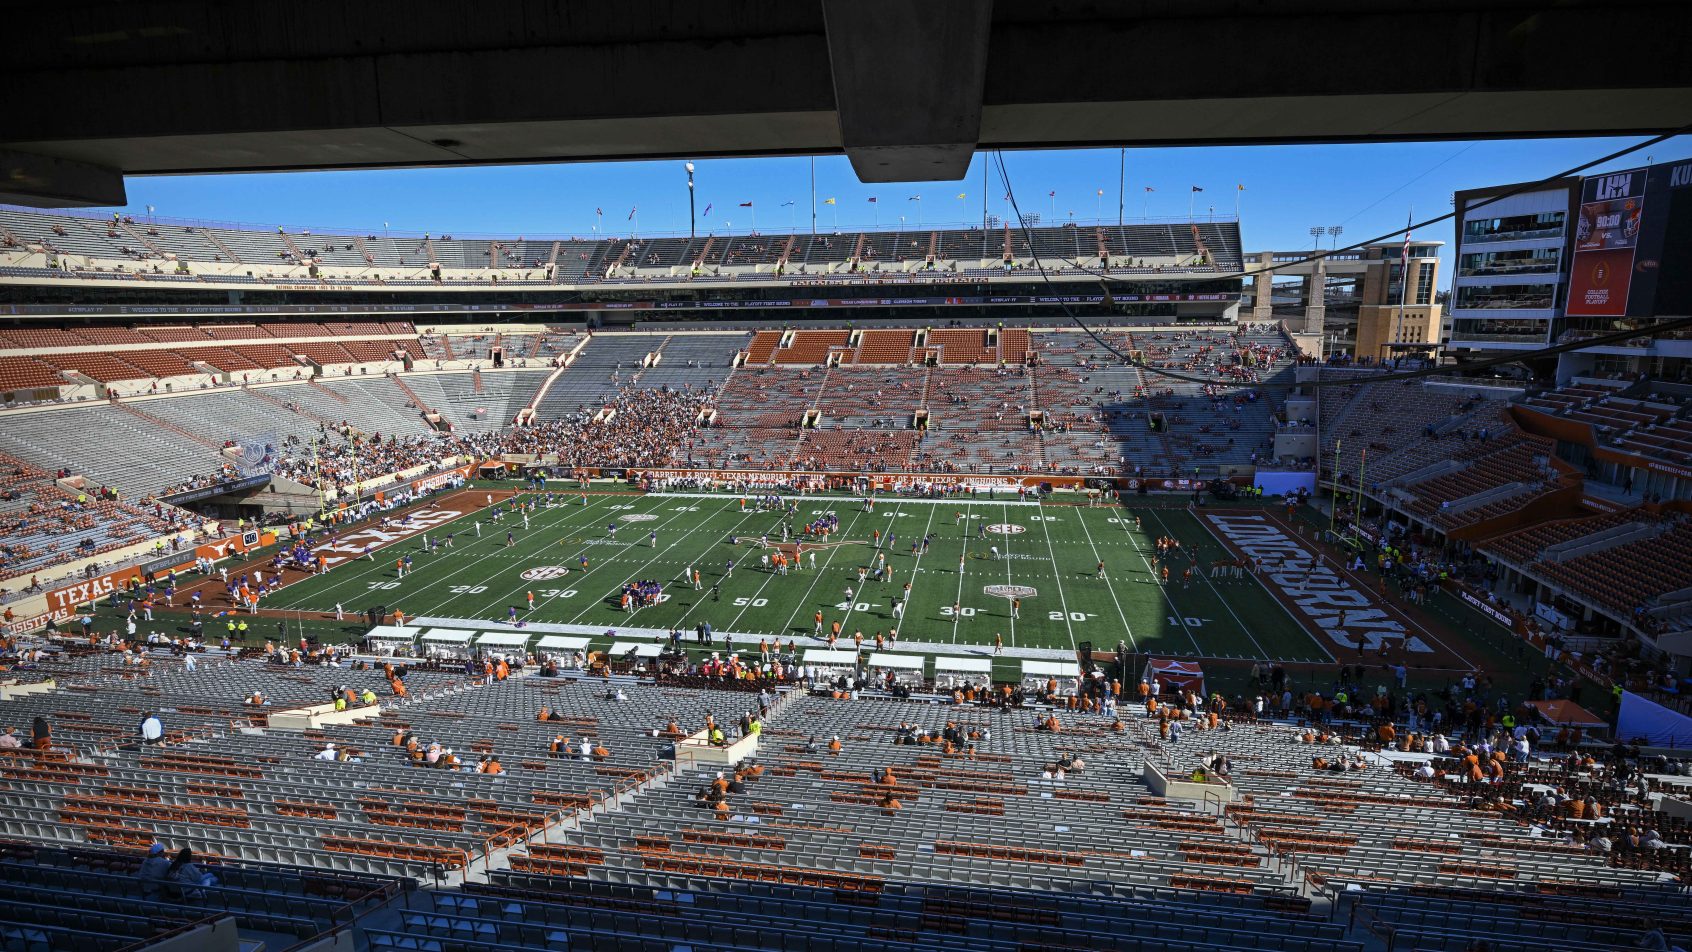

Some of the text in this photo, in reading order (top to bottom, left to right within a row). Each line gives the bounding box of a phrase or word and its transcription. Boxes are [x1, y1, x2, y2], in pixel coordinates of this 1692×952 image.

[1596, 173, 1632, 200] LHN
[1597, 215, 1620, 228] 90:00
[748, 472, 787, 480] MEMORIAL
[898, 475, 908, 483] OF
[930, 476, 956, 484] TEXAS
[990, 524, 1024, 534] SEC
[1206, 514, 1435, 653] LONGHORNS
[54, 576, 115, 607] TEXAS
[451, 586, 488, 594] 20
[541, 589, 578, 598] 30
[732, 598, 768, 607] 50
[1461, 590, 1482, 608] PLAYOFF
[940, 606, 976, 616] 30
[1049, 611, 1086, 621] 20
[1167, 616, 1201, 627] 10
